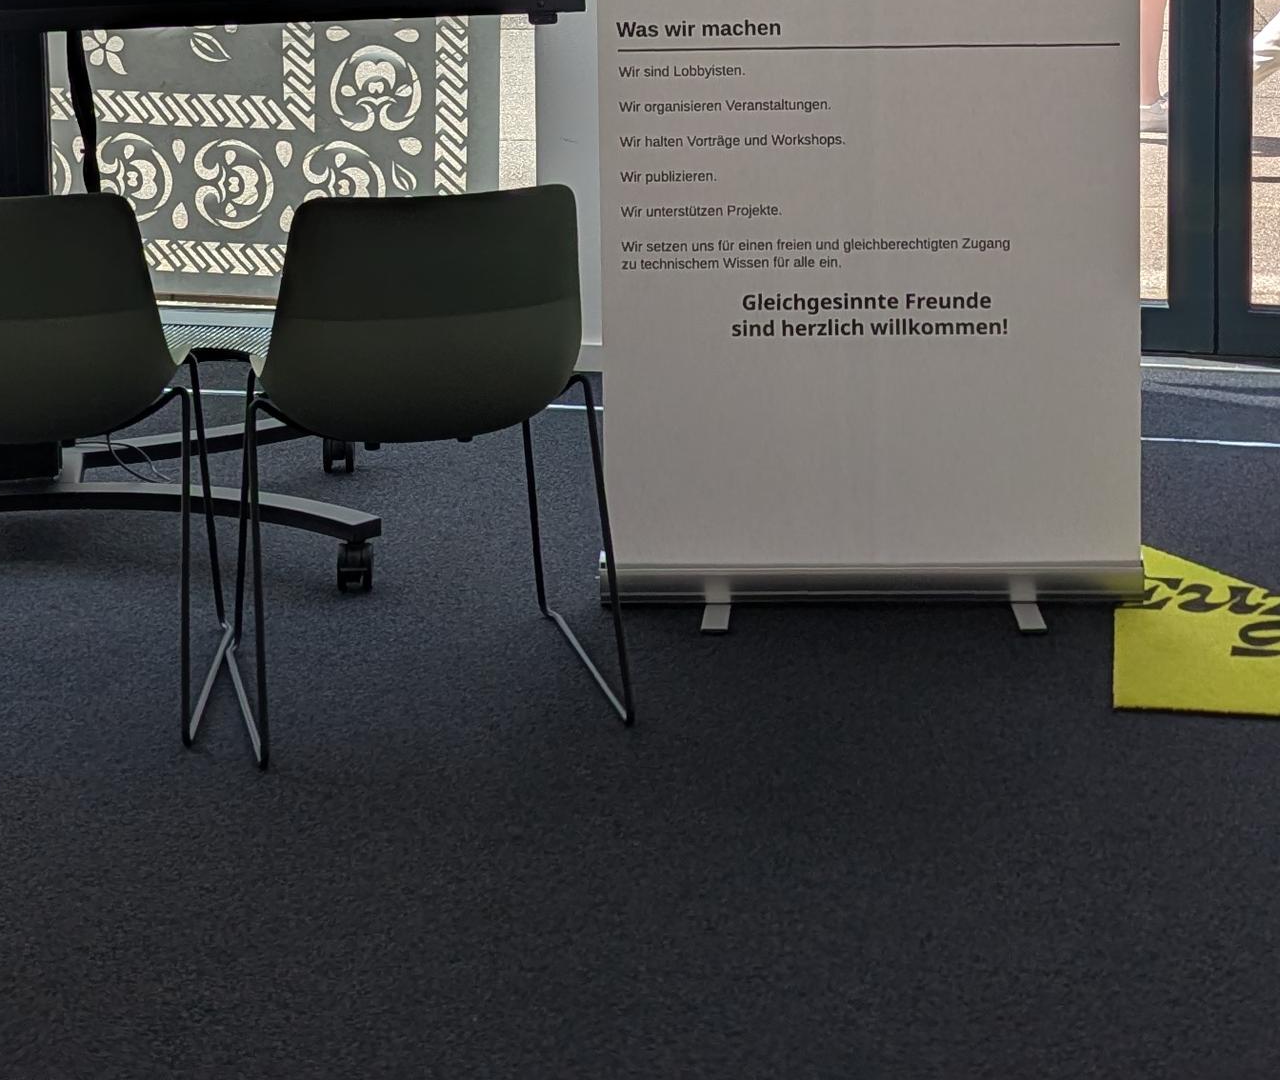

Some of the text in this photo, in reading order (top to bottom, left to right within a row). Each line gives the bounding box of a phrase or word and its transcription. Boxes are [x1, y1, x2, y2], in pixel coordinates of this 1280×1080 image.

[616, 19, 781, 37] Was wir machen
[619, 64, 745, 79] Wir sind Lobbyisten.
[619, 98, 831, 114] Wir organisieren Veranstaltungen.
[619, 133, 845, 149] Wir halten Vorträge und Workshops.
[621, 169, 717, 185] Wir publizieren.
[621, 203, 782, 219] Wir unterstützen Projekte.
[622, 237, 1010, 253] Wir setzen uns für einen freien und gleichberechtigten Zugang
[622, 255, 841, 270] zu technischem Wissen für alle ein.
[743, 292, 991, 315] Gleichgesinnte Freunde
[732, 318, 1007, 337] sind herzlich willkommen!
